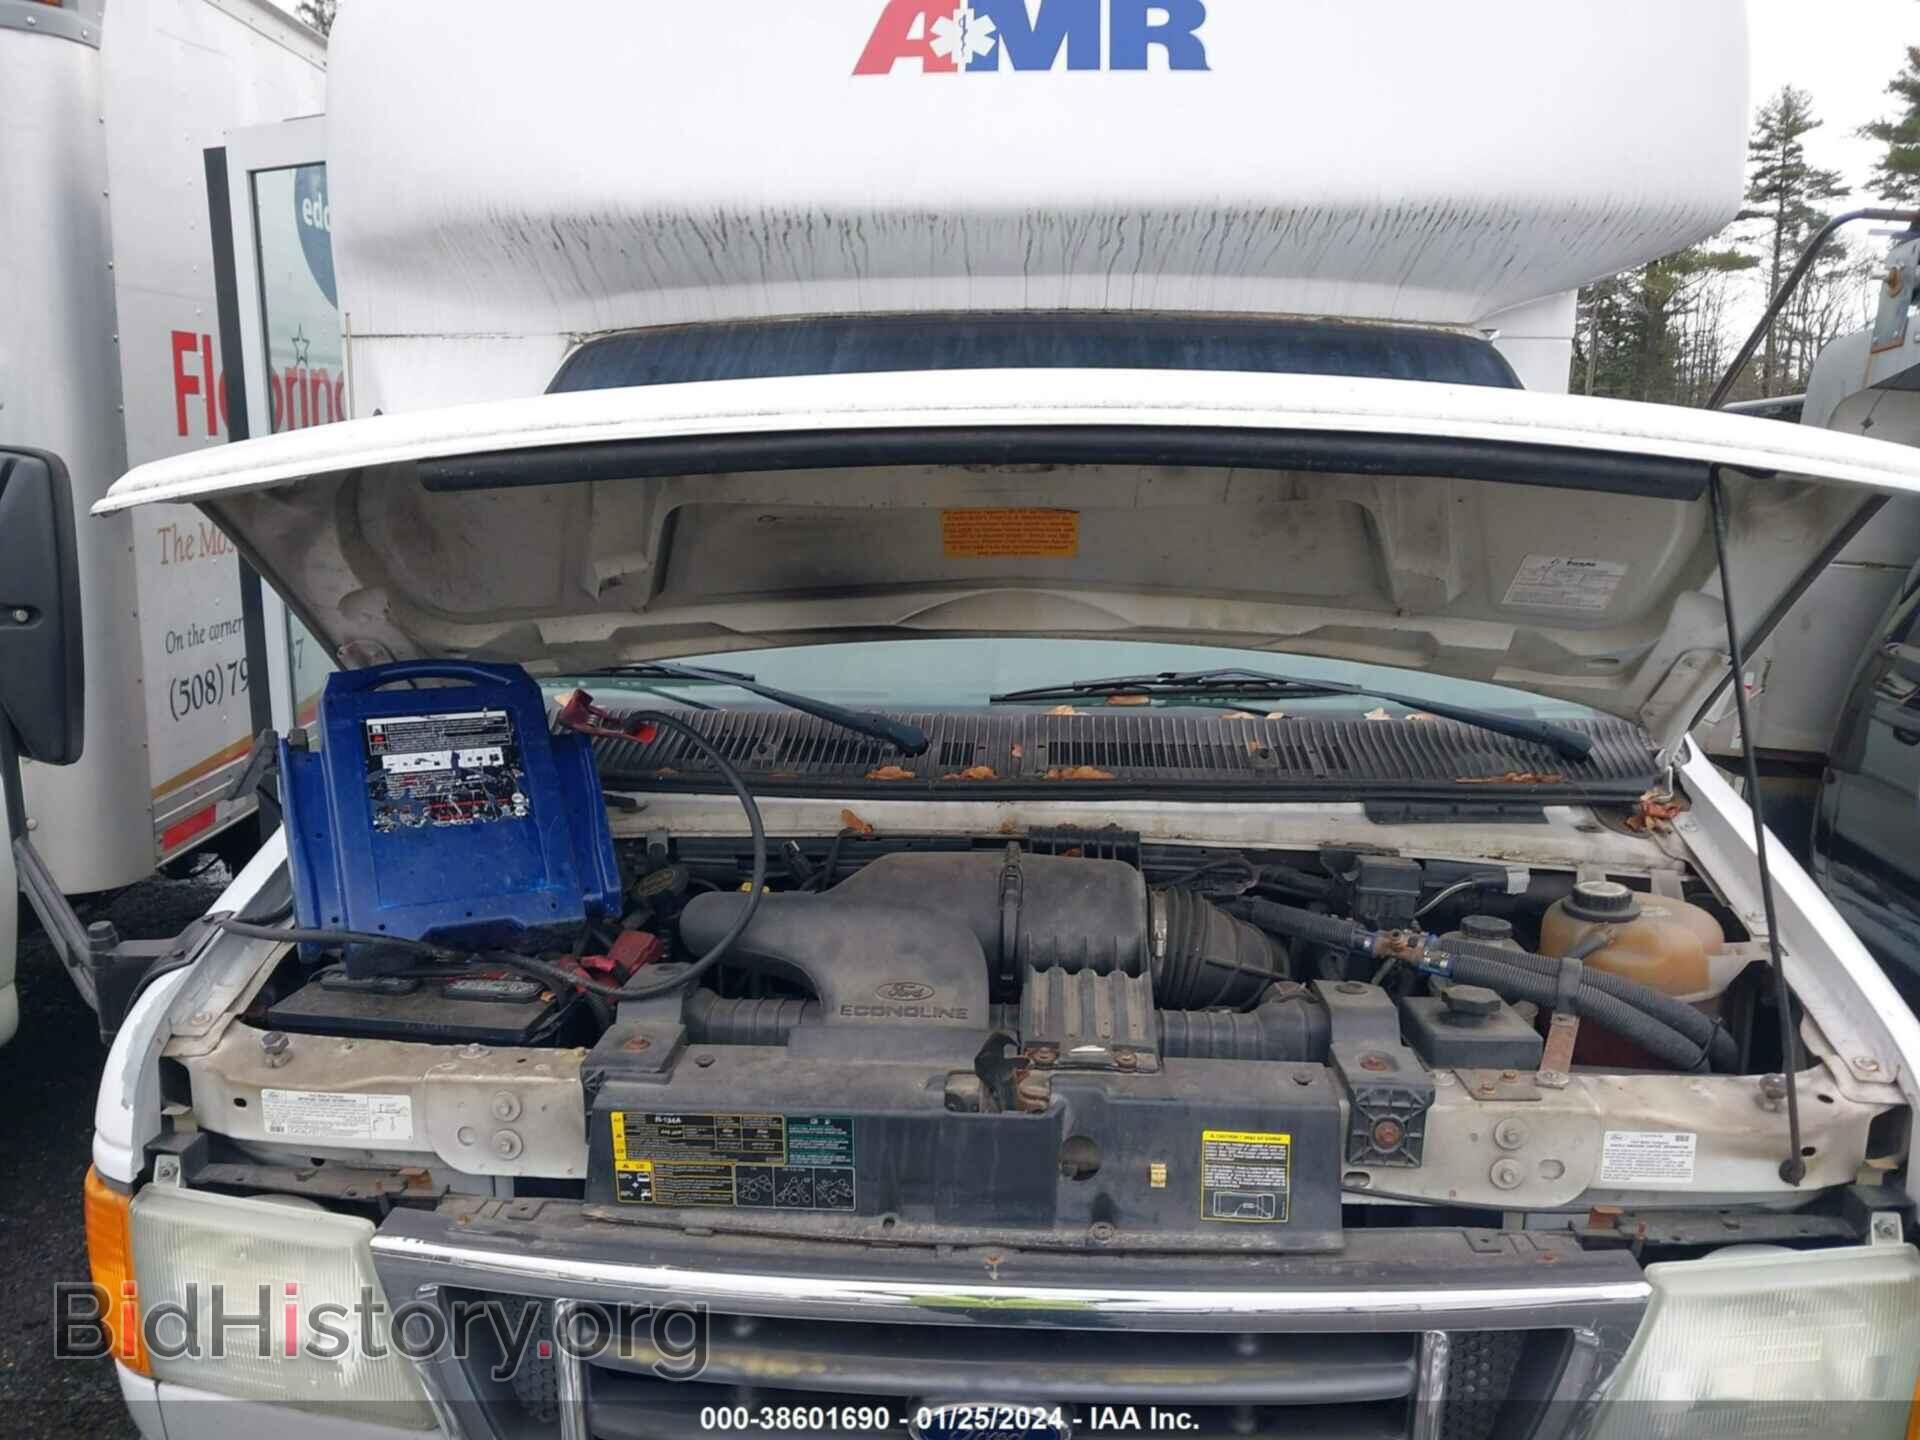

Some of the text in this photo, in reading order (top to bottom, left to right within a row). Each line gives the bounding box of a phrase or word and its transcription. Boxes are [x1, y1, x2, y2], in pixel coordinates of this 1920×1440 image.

[851, 0, 1212, 75] AMR
[158, 522, 193, 565] The
[165, 617, 243, 654] On the corner
[170, 663, 224, 722] (508)
[839, 1004, 969, 1020] ECONOLINE
